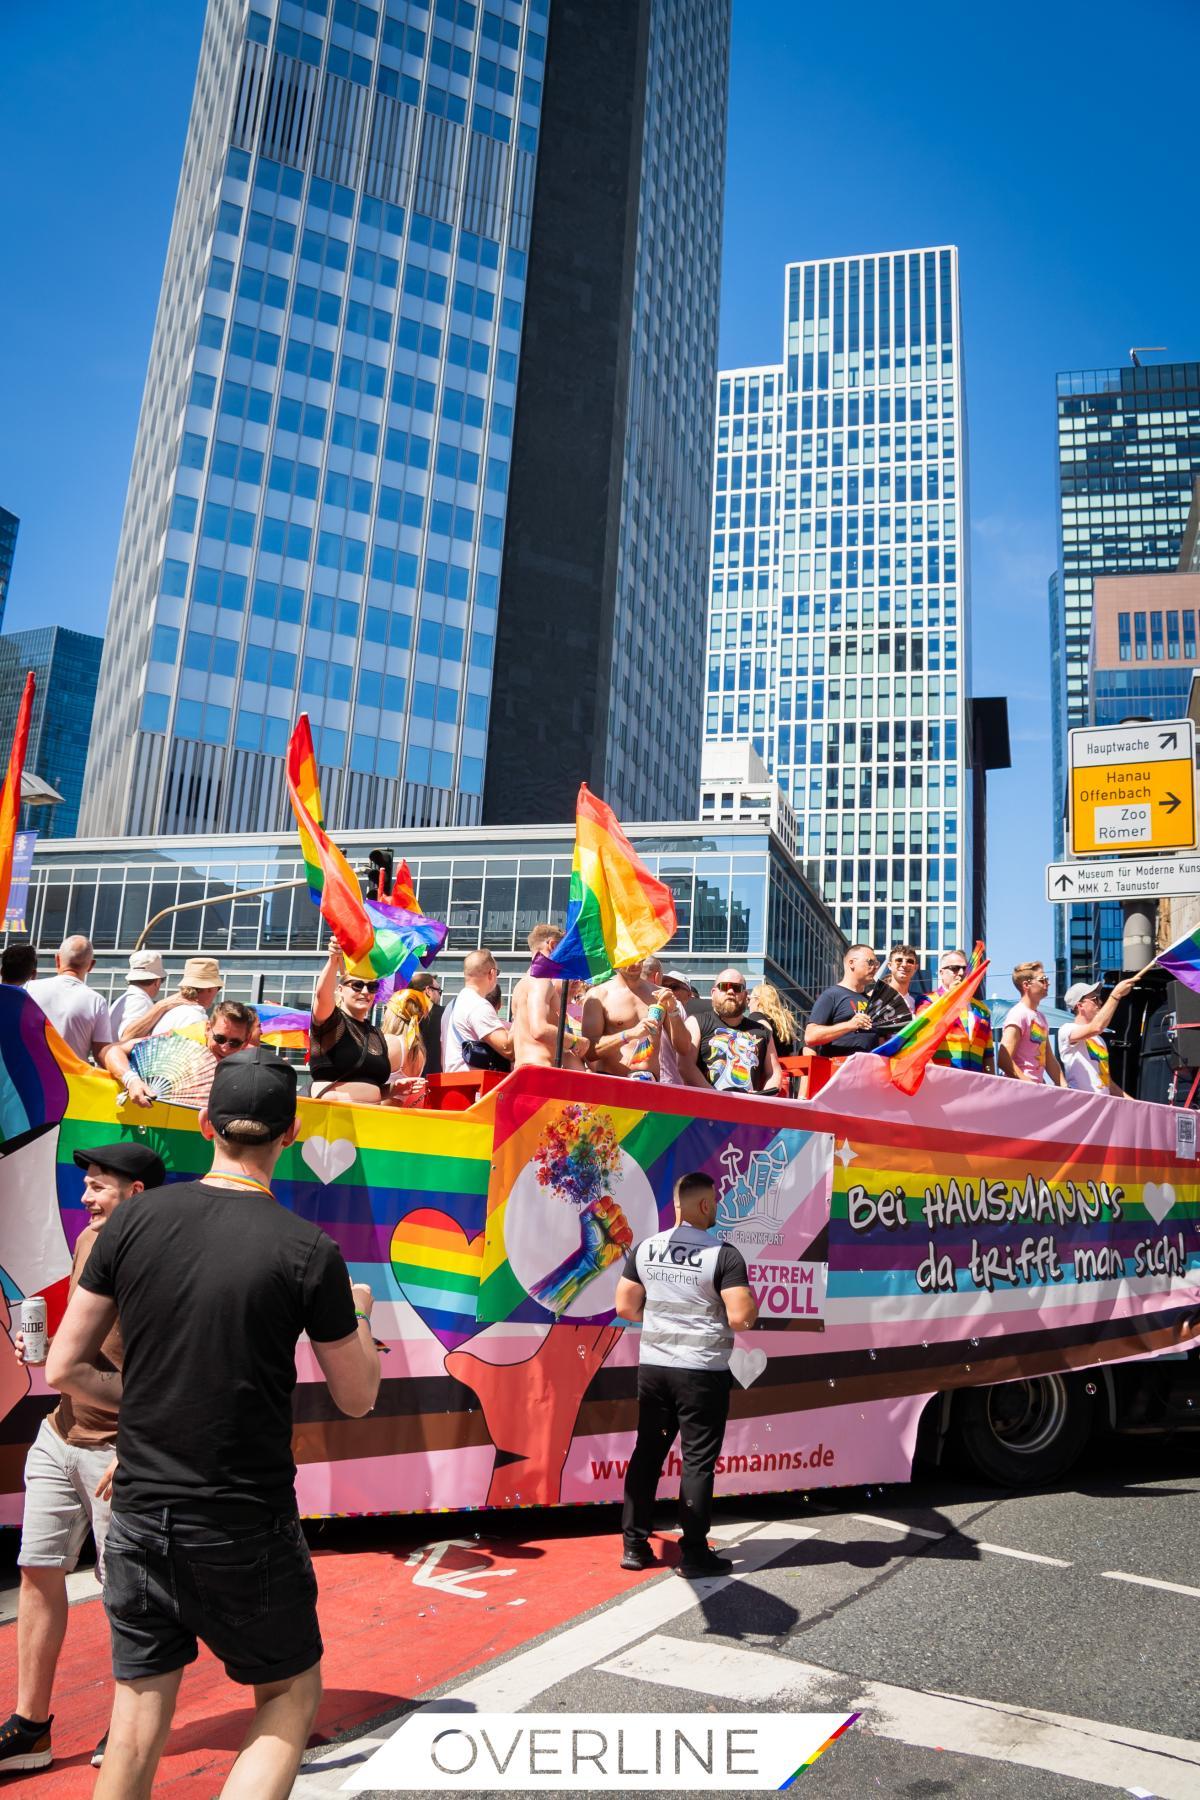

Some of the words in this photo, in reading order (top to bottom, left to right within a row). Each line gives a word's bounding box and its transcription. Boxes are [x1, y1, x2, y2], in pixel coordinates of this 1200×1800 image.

[1087, 740, 1150, 756] Hauptwache
[1106, 771, 1151, 783] Hanau
[1080, 786, 1151, 802] Offenbach
[1121, 808, 1147, 821] Zoo
[1099, 826, 1147, 839] Römer
[1078, 869, 1114, 879] Museum
[1118, 867, 1131, 877] für
[1136, 864, 1175, 876] Moderne
[1078, 883, 1099, 893] MMK
[1116, 881, 1160, 892] Taunustor
[847, 1184, 908, 1231] Bei
[716, 1229, 734, 1242] CSD
[735, 1230, 785, 1246] FRANKFURT
[648, 1243, 703, 1267] WGG
[916, 1240, 955, 1290] da
[1073, 1246, 1125, 1280] man
[1134, 1231, 1185, 1276] sich!
[646, 1267, 700, 1287] Sicherheit
[748, 1264, 814, 1284] EXTREM
[749, 1284, 819, 1314] VOLL
